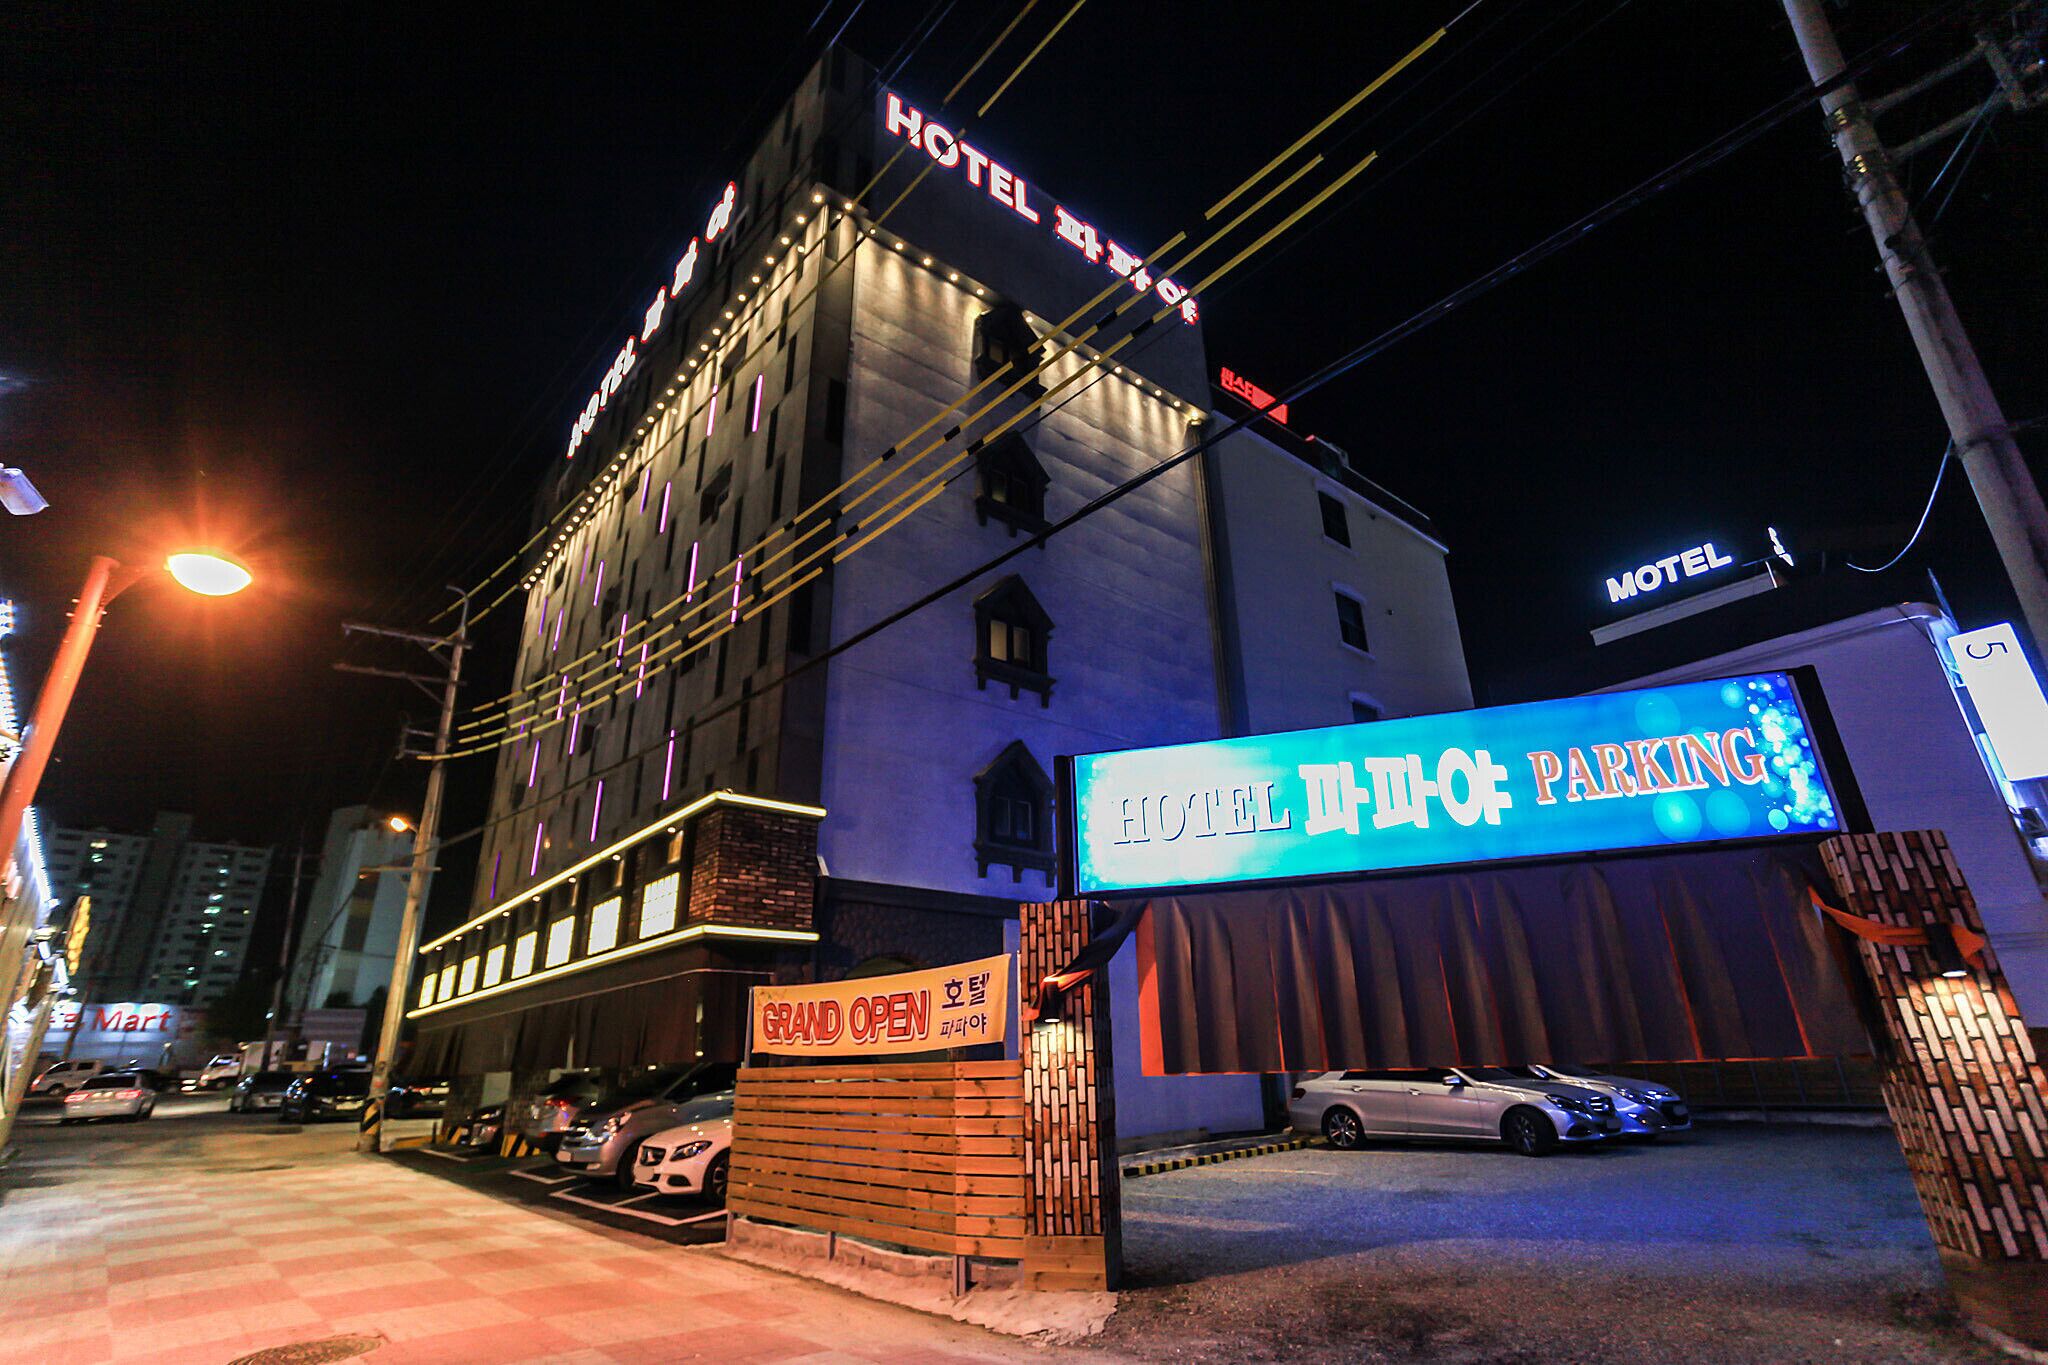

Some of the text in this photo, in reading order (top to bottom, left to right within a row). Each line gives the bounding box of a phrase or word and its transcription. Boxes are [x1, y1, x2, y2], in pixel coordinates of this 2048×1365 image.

[887, 92, 1198, 325] HOTEL 파파야
[567, 335, 636, 459] HOTEL
[1606, 543, 1732, 602] MOTEL
[1113, 728, 1767, 845] HOTEL 파파야 PARKING
[92, 1007, 173, 1032] Mart
[763, 990, 931, 1045] GRAND OPEN
[941, 973, 990, 1009] 호텔
[940, 1013, 988, 1039] 파파야
